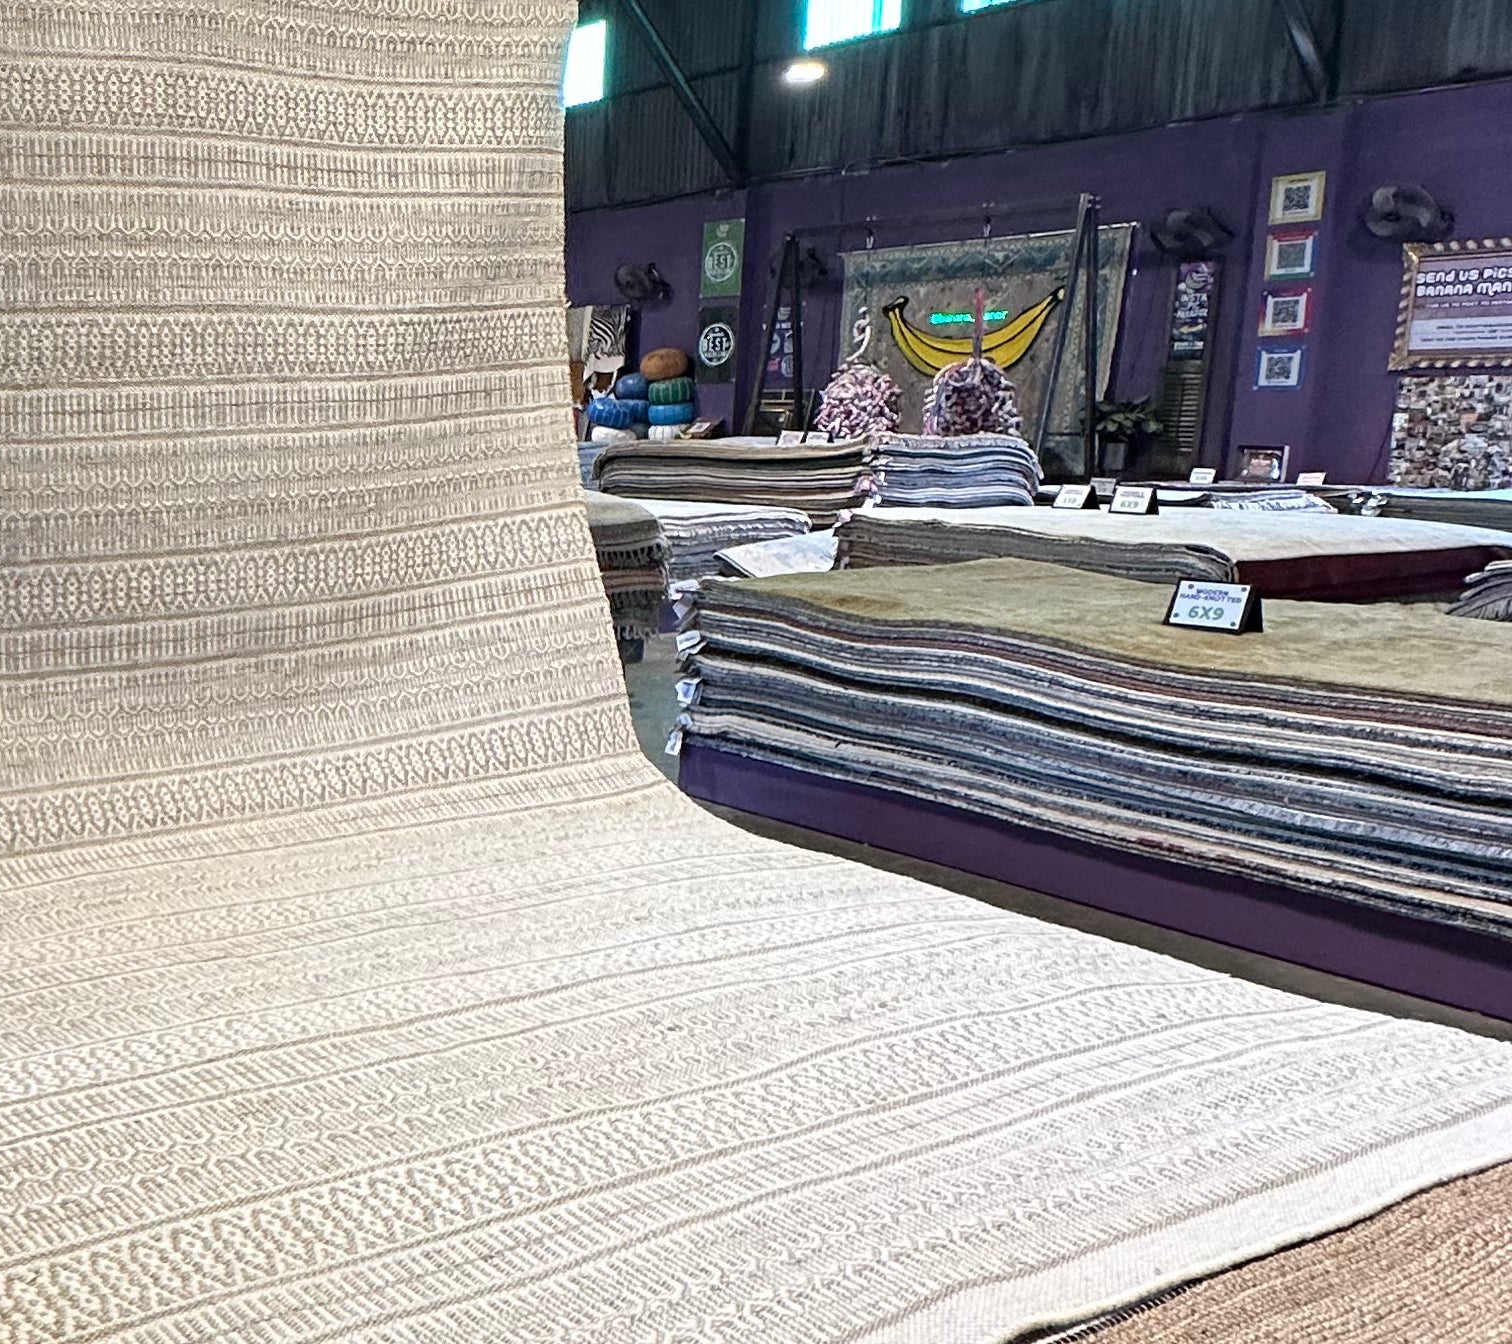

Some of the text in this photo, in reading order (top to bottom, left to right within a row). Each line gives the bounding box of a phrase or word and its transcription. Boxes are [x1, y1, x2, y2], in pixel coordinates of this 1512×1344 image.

[1416, 270, 1456, 284] SEND
[1459, 269, 1479, 282] US
[1416, 283, 1473, 297] BANANA
[703, 336, 728, 353] BEST
[1196, 588, 1229, 596] MODERN
[1188, 605, 1225, 620] 6X9
